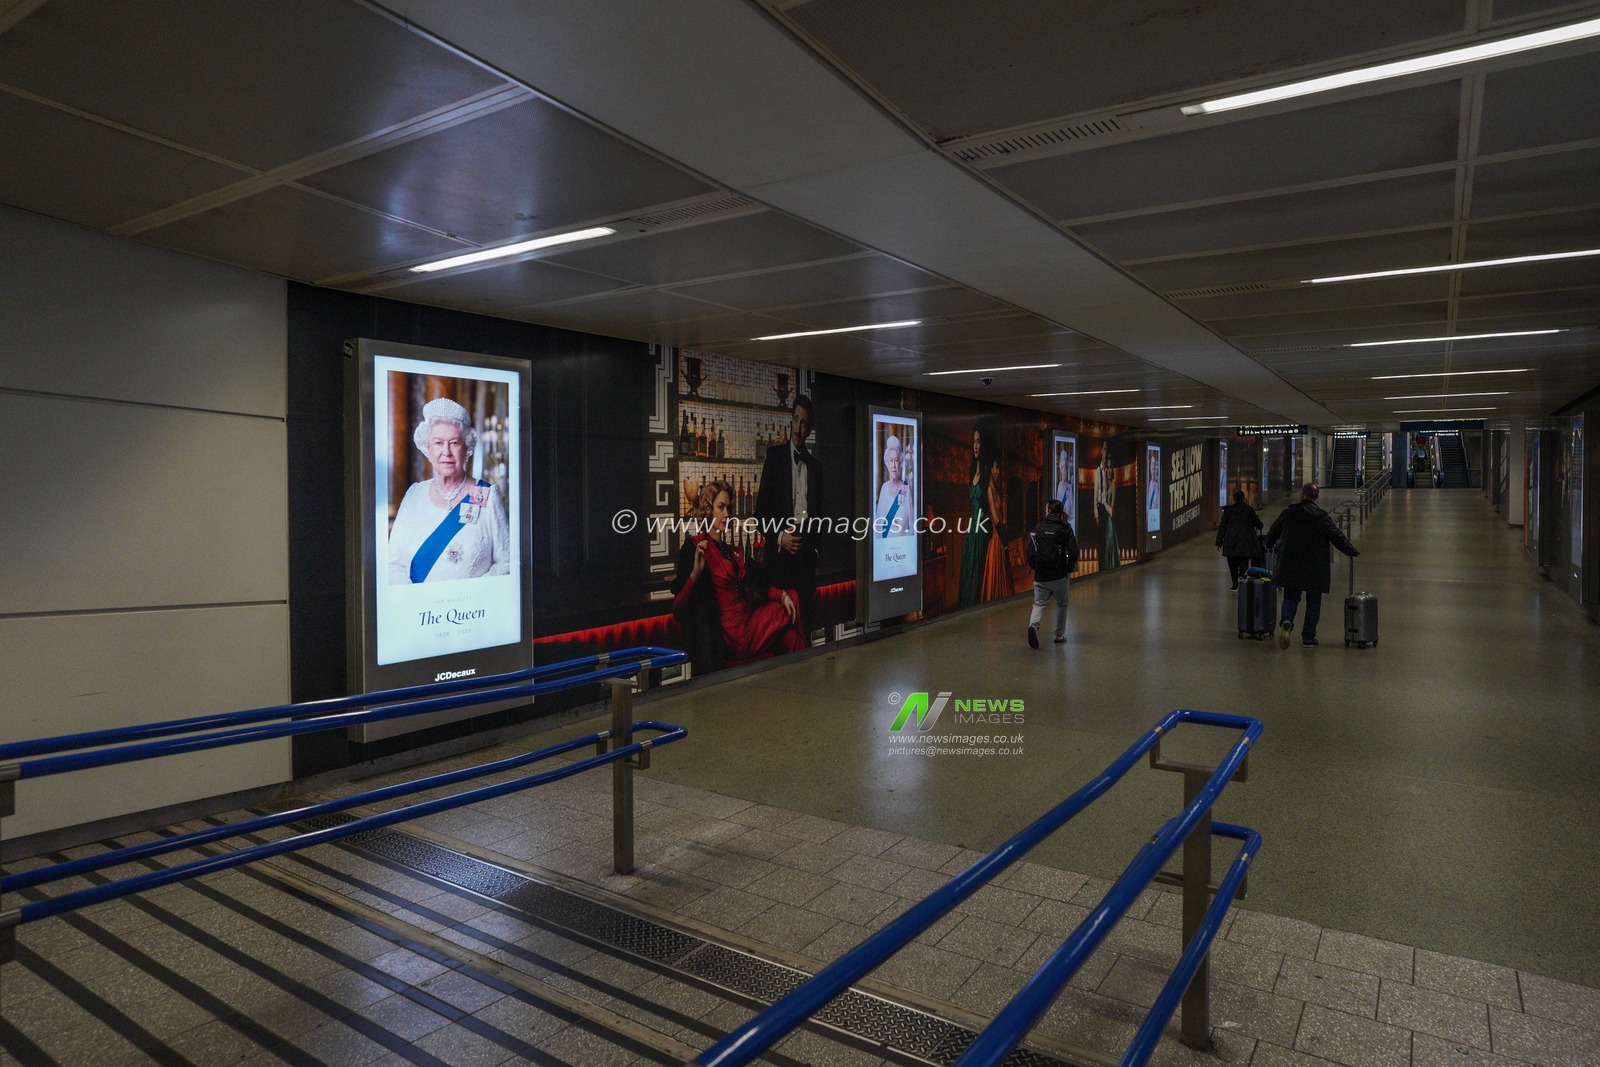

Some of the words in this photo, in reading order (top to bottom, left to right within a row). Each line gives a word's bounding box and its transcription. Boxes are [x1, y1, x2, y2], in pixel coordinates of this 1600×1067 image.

[1171, 448, 1185, 481] SEE
[1185, 443, 1203, 475] HOW
[1169, 476, 1190, 513] THEY
[1190, 470, 1203, 503] RUN
[884, 553, 892, 562] The
[893, 553, 907, 562] Queen
[419, 610, 442, 626] The
[446, 608, 485, 625] Queen
[435, 668, 476, 682] JCDecaux
